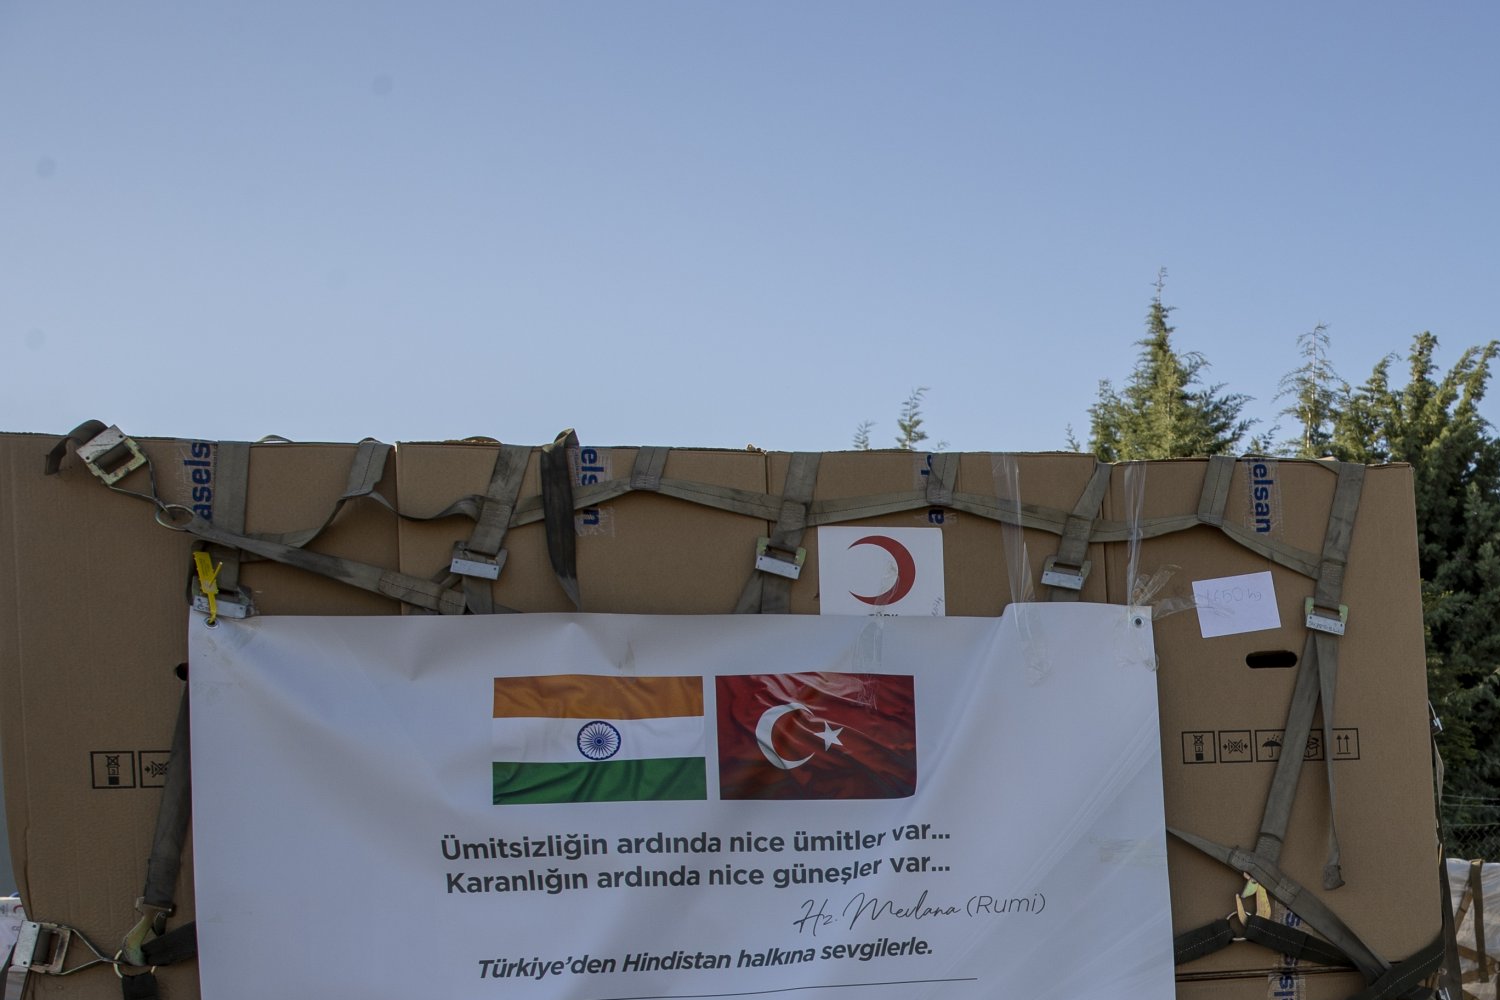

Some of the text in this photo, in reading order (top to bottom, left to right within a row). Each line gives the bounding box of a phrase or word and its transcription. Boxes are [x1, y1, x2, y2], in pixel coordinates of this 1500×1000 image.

[191, 443, 212, 521] asels
[581, 449, 604, 525] elsn
[1253, 462, 1273, 533] elsan
[440, 823, 951, 861] Ümitsizliğin ardında nice ümitler var...
[446, 854, 951, 895] Karanlığın ardında nice güneşler var...
[966, 893, 1046, 917] (Rumi)
[478, 937, 933, 980] Türkiye'den Hindistan halkına sevgilerle.
